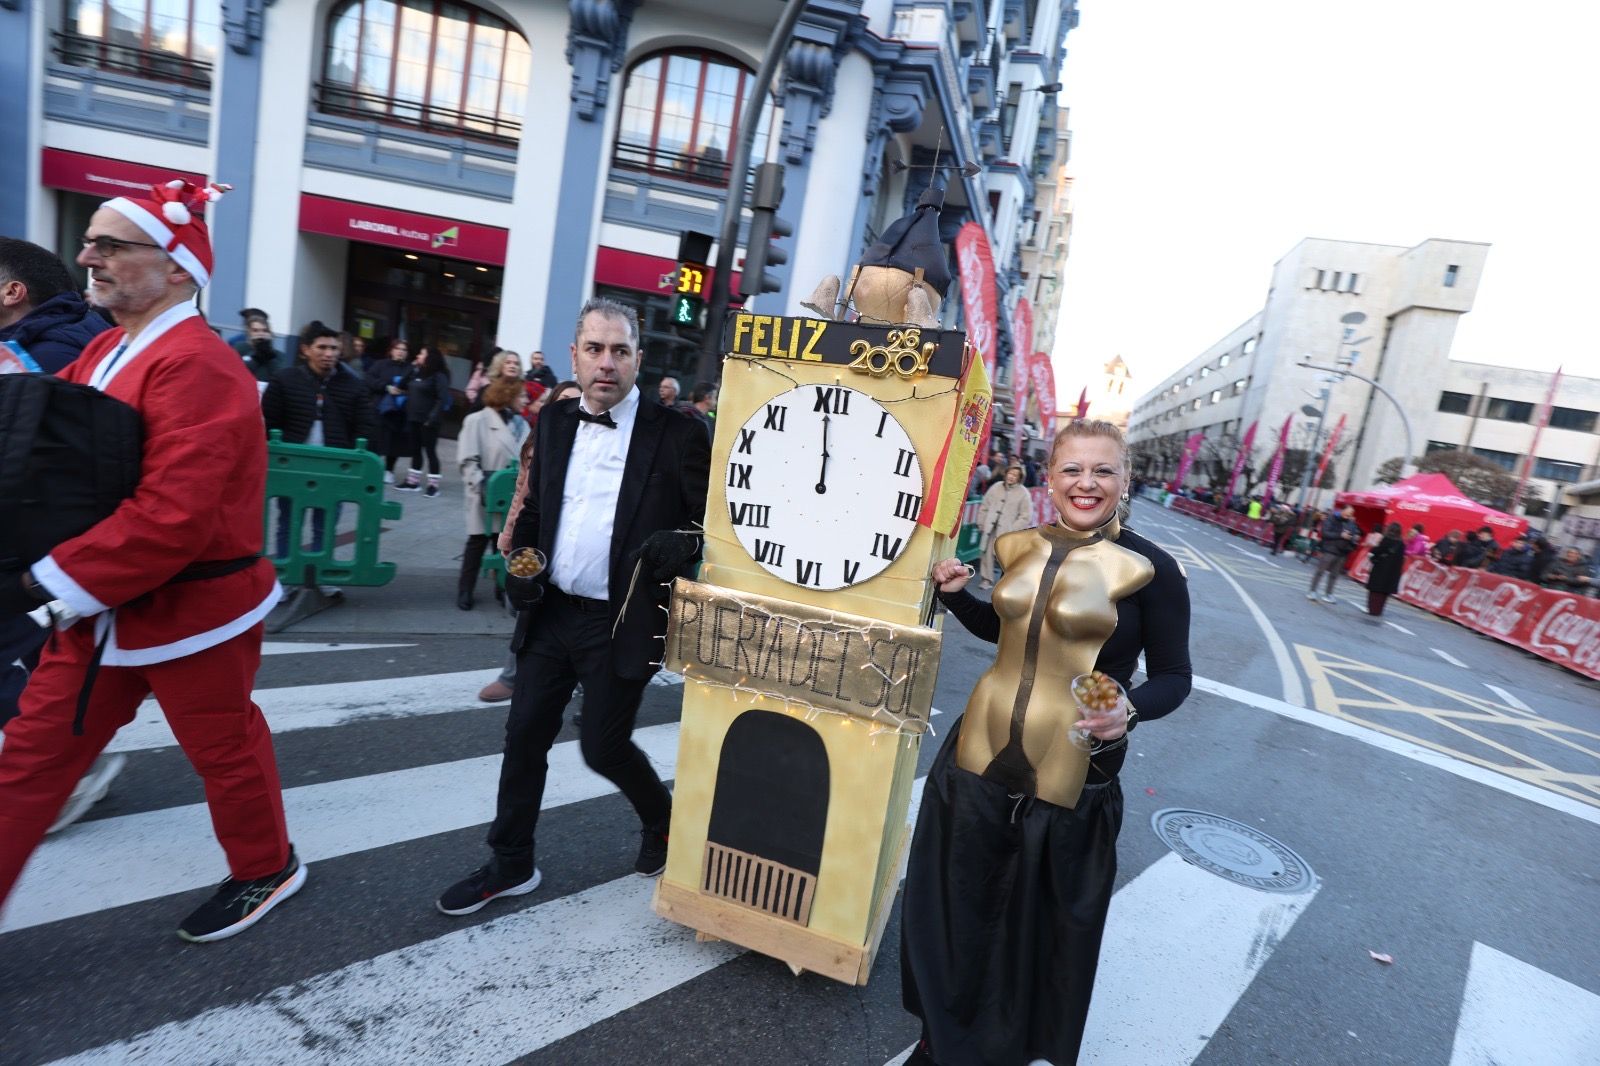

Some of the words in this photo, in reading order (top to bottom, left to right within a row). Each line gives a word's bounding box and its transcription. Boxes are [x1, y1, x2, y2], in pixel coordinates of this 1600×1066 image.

[678, 267, 703, 293] 37
[733, 314, 828, 362] FELIZ
[813, 386, 852, 415] XII
[764, 404, 788, 432] XI
[875, 411, 890, 438] I
[738, 428, 756, 455] X
[728, 462, 753, 490] IX
[893, 448, 916, 478] II
[729, 501, 771, 528] VIII
[893, 491, 922, 522] III
[754, 538, 786, 568] VII
[870, 533, 903, 561] IV
[796, 559, 822, 586] VI
[843, 559, 860, 585] V
[789, 624, 852, 702] DEL
[859, 637, 921, 719] SOL
